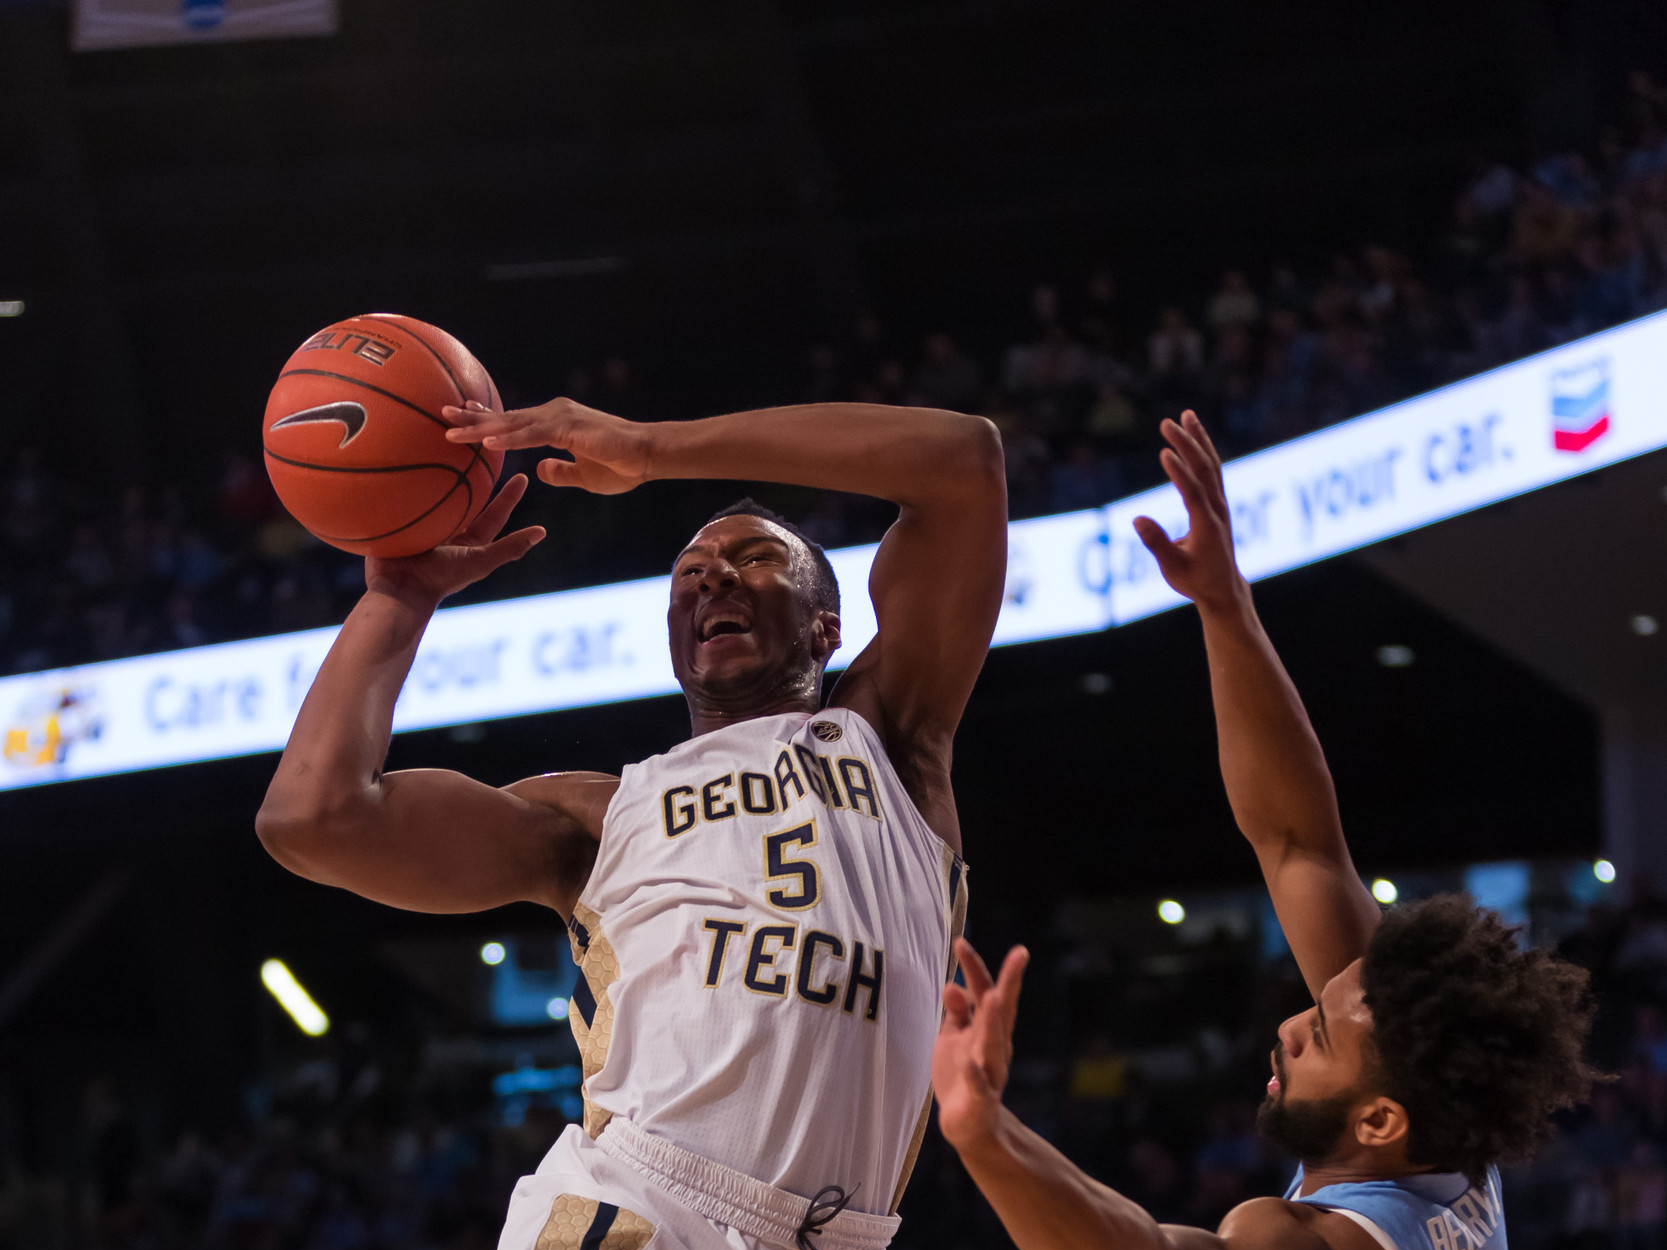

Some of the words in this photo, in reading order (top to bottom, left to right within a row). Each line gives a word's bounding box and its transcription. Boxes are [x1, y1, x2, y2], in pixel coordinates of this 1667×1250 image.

[302, 332, 397, 367] ELITE
[1296, 446, 1403, 543] your
[1423, 413, 1514, 484] car.
[143, 674, 264, 734] Care
[530, 618, 636, 678] car.
[661, 742, 882, 840] GEORGIA
[762, 819, 823, 912] 5
[702, 918, 886, 1022] TECH
